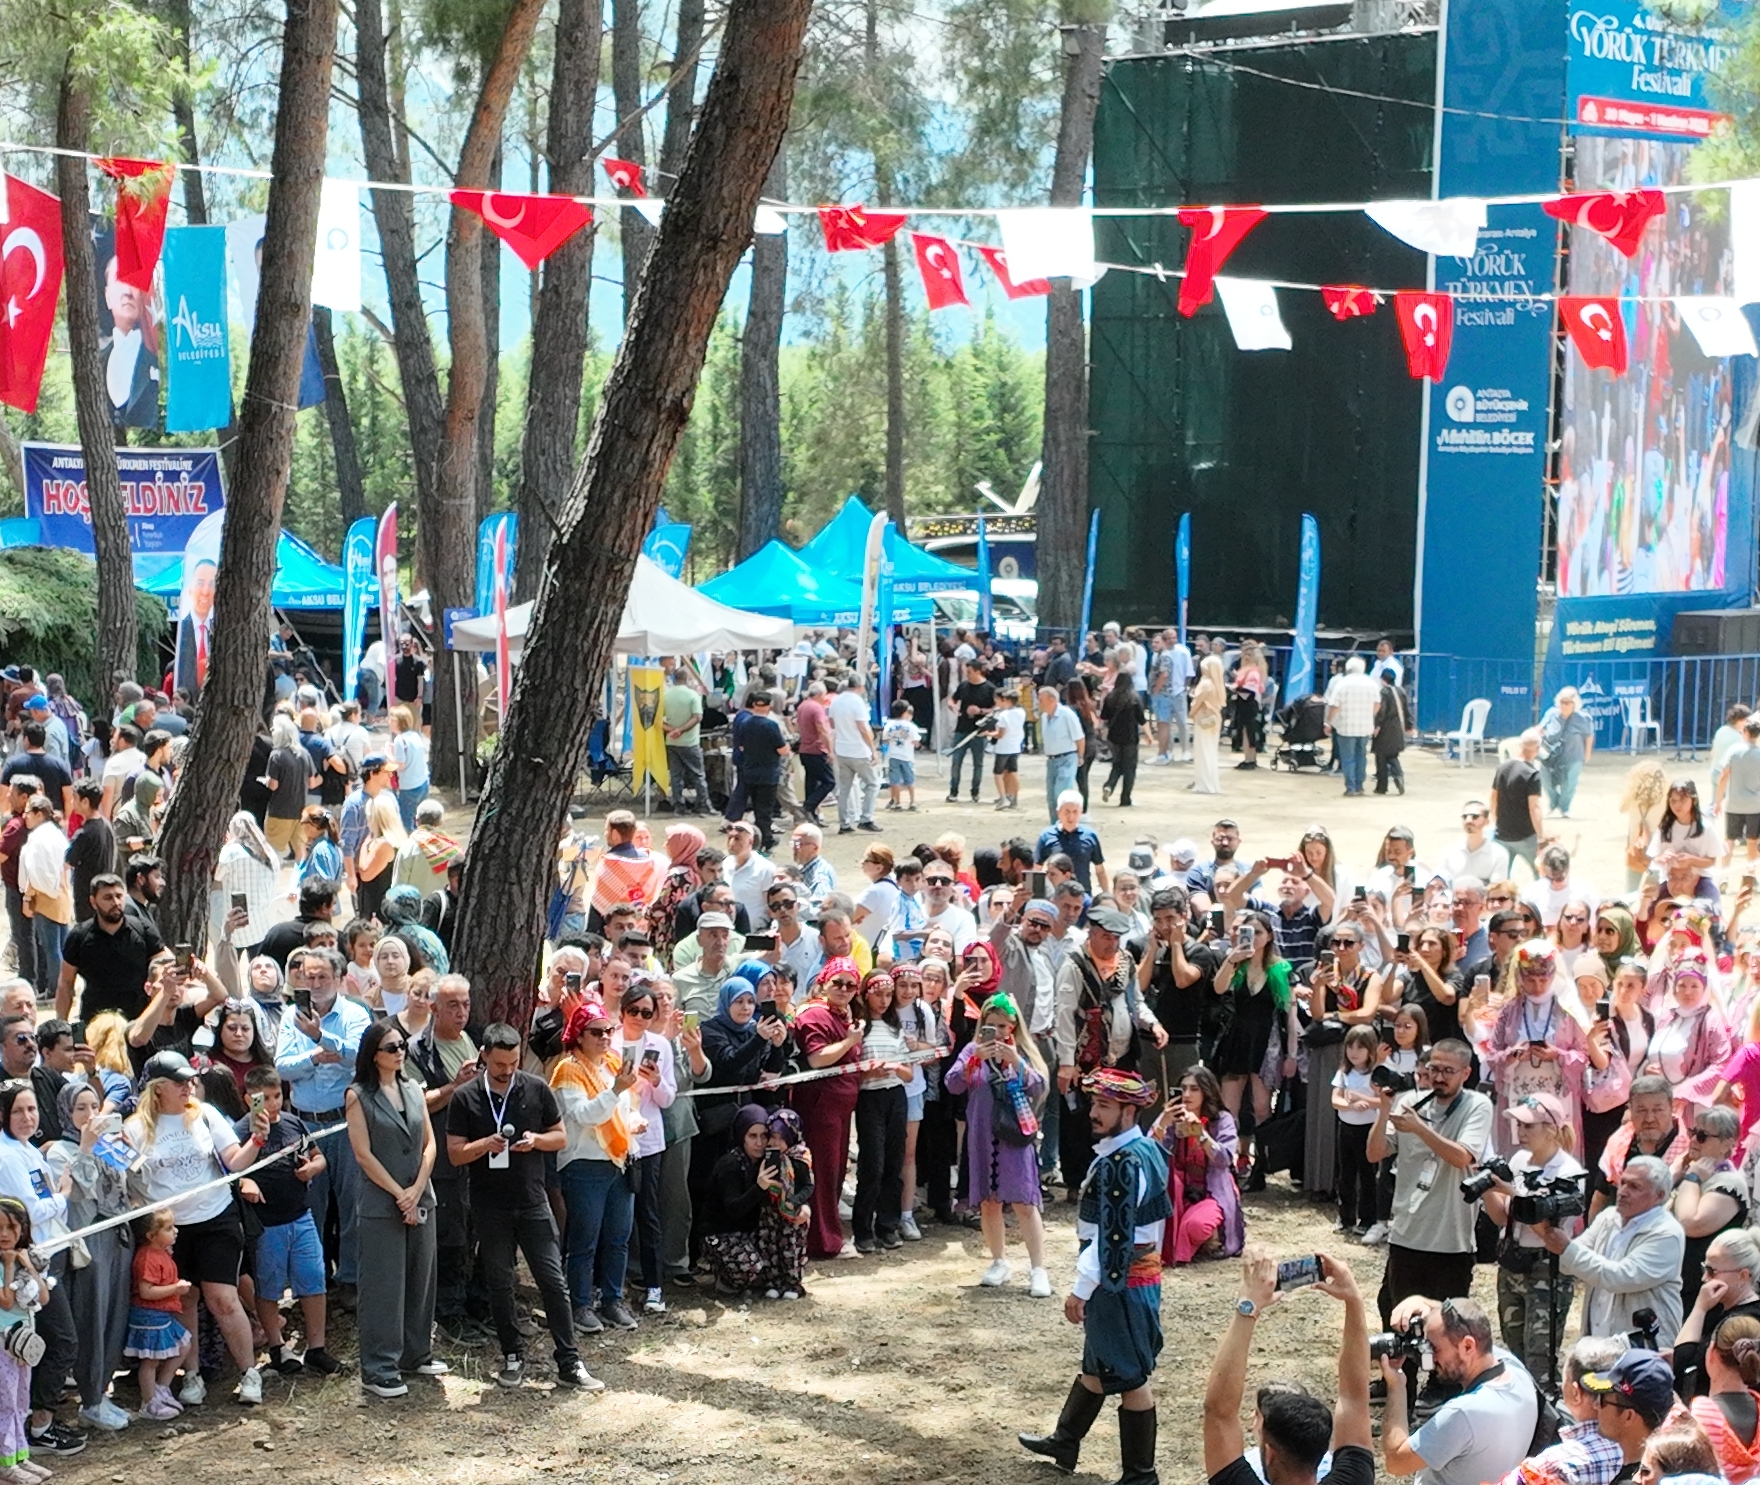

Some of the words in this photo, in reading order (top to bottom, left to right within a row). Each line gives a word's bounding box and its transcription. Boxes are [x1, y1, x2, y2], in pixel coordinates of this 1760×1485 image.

[1570, 10, 1648, 64] YÖRÜK
[1631, 64, 1691, 97] Festivali
[1454, 243, 1526, 277] YÖRÜK
[1445, 277, 1548, 317] TÜRKMEN
[172, 294, 223, 350] Aksu
[1456, 307, 1515, 326] Festivali
[1492, 428, 1535, 446] BÖCEK
[52, 456, 84, 469] ANTALY
[117, 458, 149, 471] ÜRKMEN
